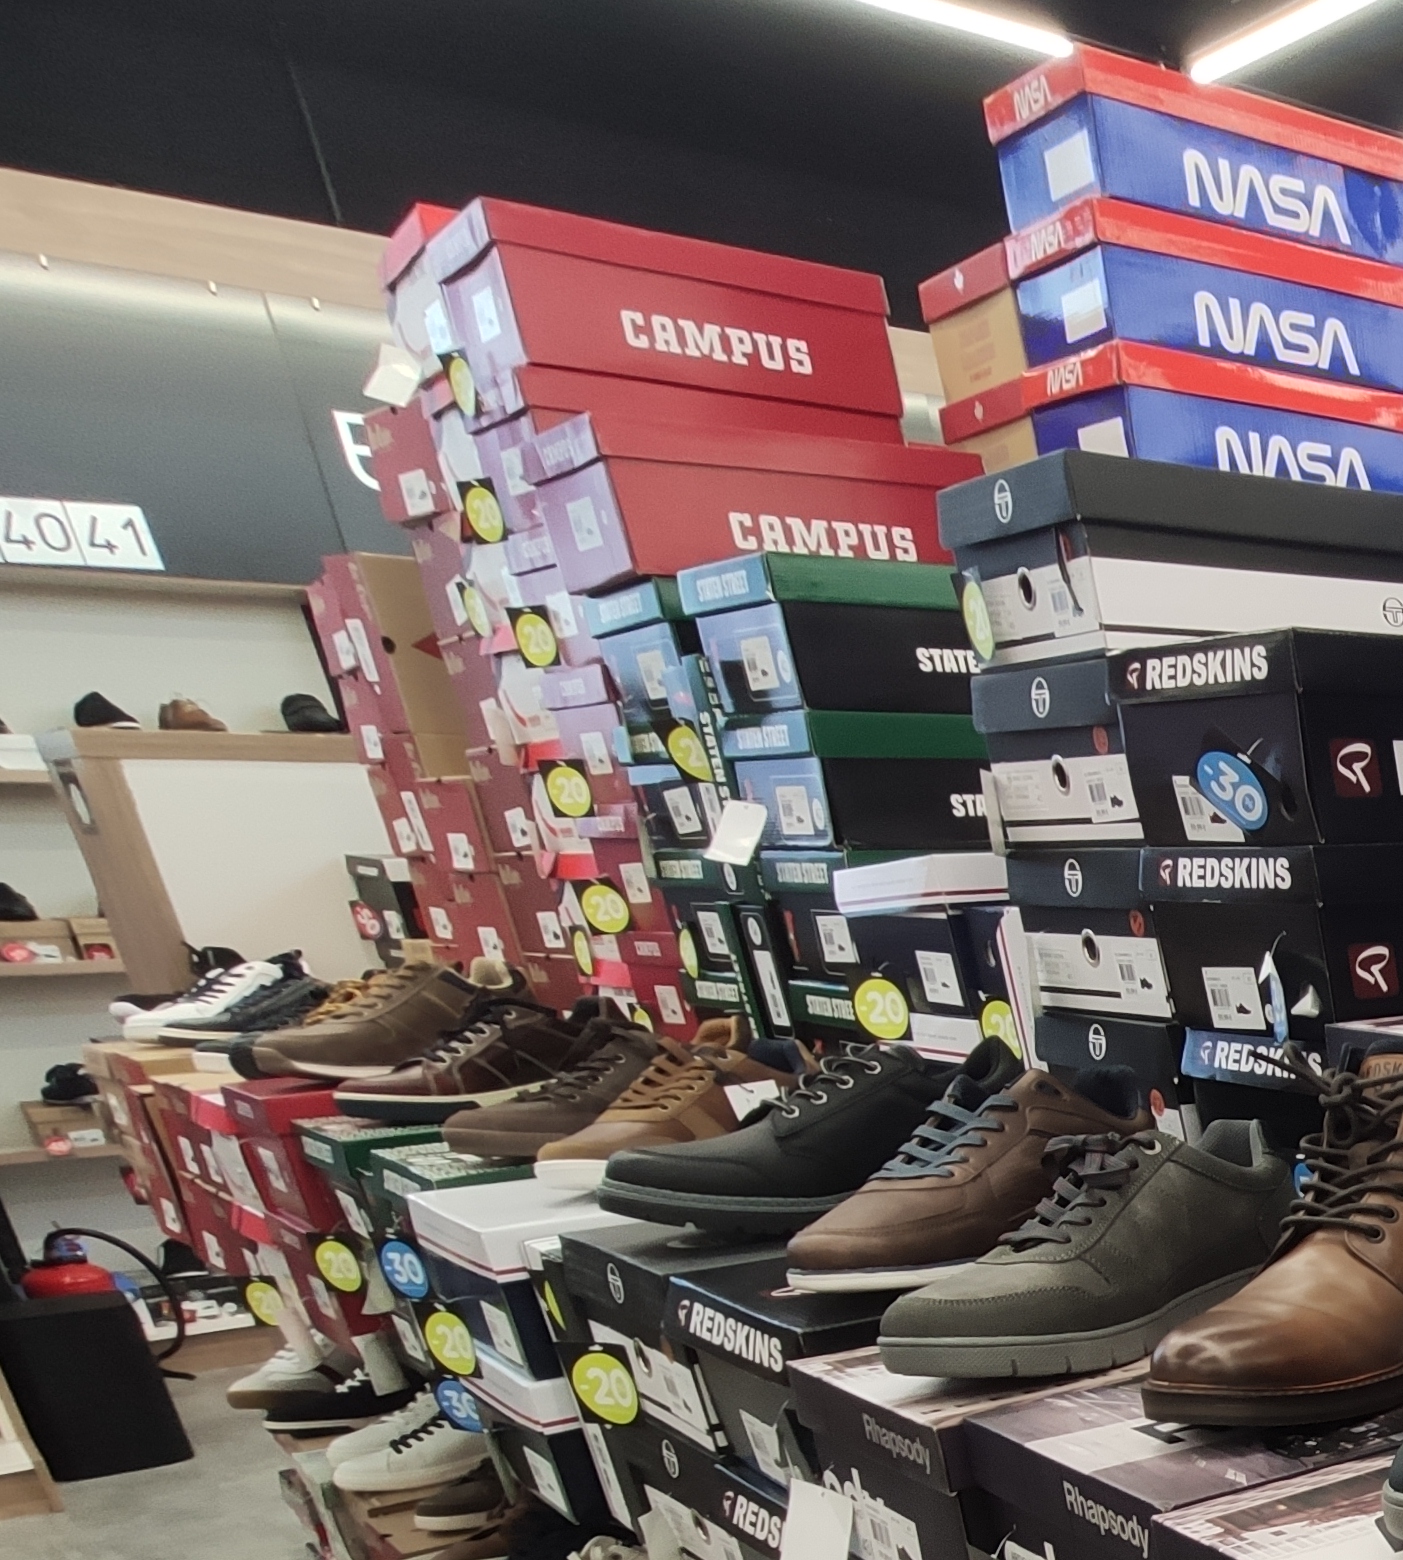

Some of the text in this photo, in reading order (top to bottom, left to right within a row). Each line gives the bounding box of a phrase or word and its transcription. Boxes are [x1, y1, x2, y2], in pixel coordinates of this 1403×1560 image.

[1013, 75, 1051, 121] NASA
[1182, 148, 1352, 246] NASA
[1029, 220, 1063, 260] NASA
[620, 309, 813, 375] CAMPUS
[1193, 291, 1360, 376] NASA
[1047, 362, 1084, 396] NASA
[1214, 426, 1371, 491] NASA
[2, 510, 147, 558] 40 41
[728, 512, 918, 563] CAMPUS
[1145, 645, 1269, 690] REDSKINS
[1177, 856, 1292, 890] REDSKINS
[690, 1300, 784, 1373] REDSKINS
[861, 1412, 931, 1474] Rhapsody
[1062, 1480, 1149, 1558] Rhapsody
